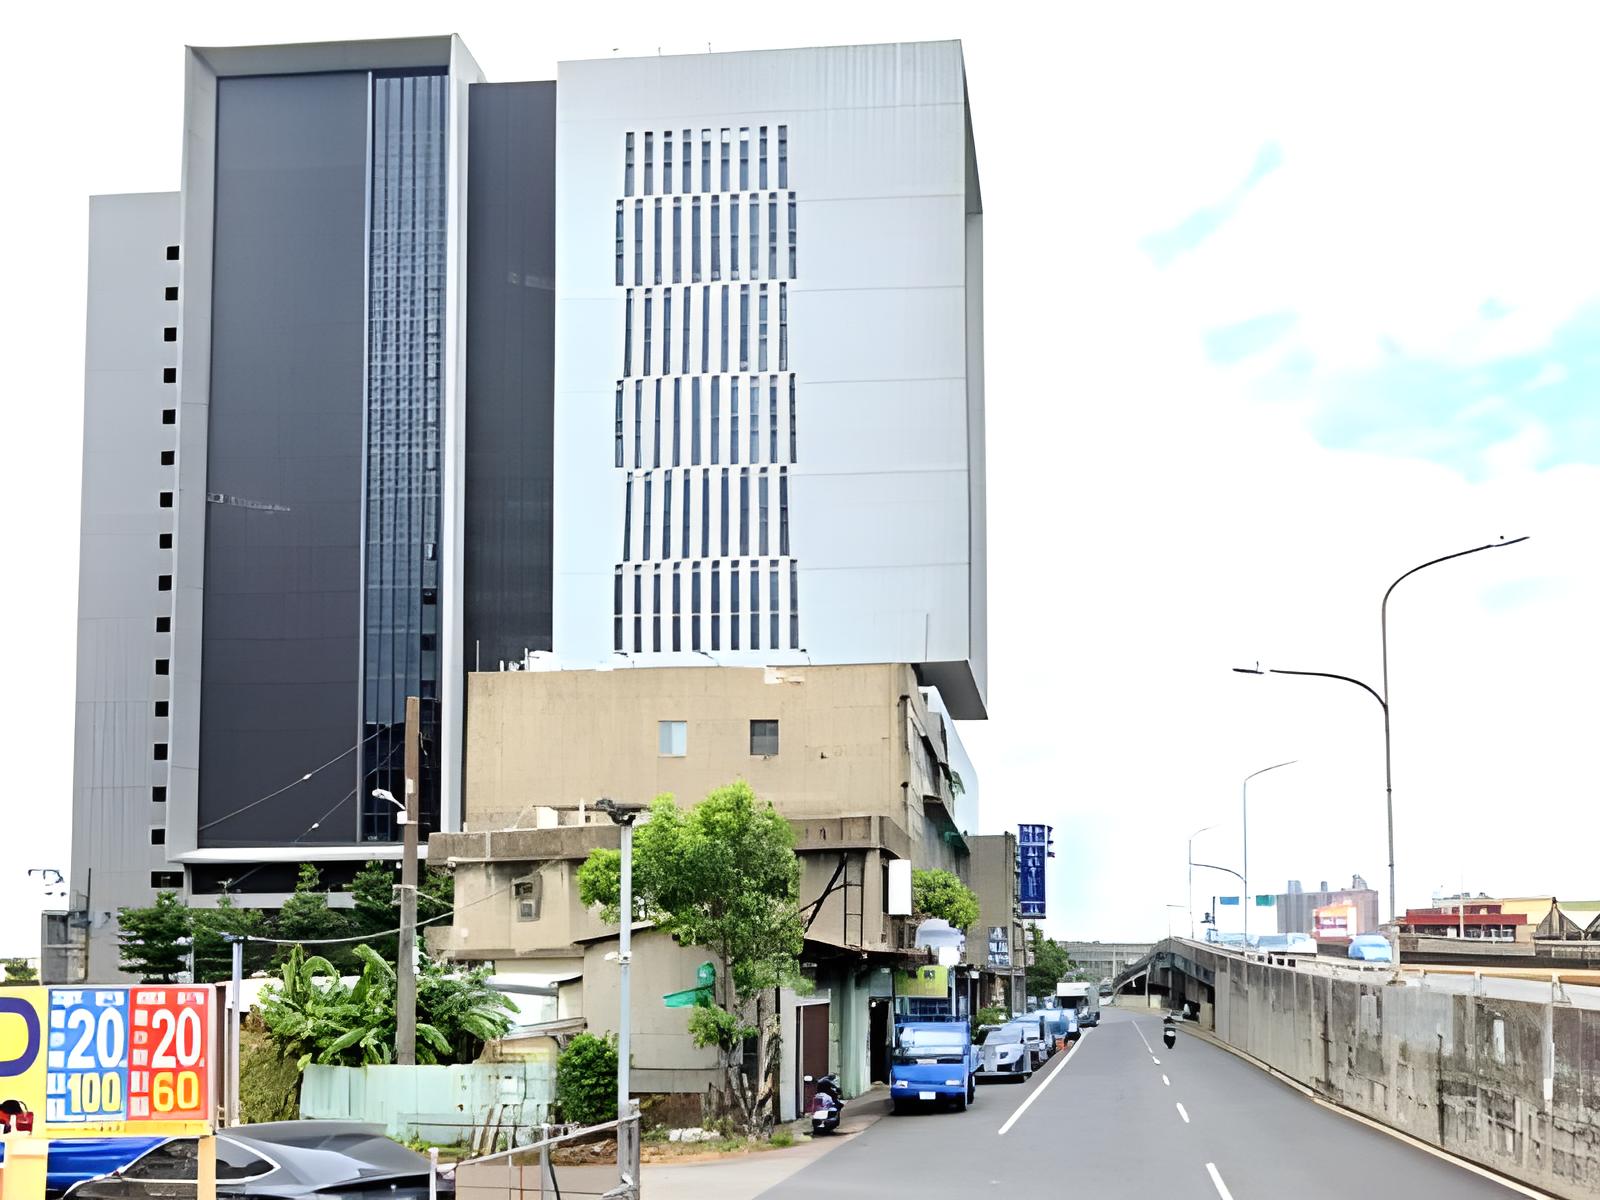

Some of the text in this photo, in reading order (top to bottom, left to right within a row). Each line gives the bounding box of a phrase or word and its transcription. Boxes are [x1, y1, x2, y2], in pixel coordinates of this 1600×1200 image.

[67, 1007, 125, 1069] 20
[151, 1007, 202, 1069] 20
[67, 1071, 121, 1113] 100
[152, 1070, 200, 1112] 60
